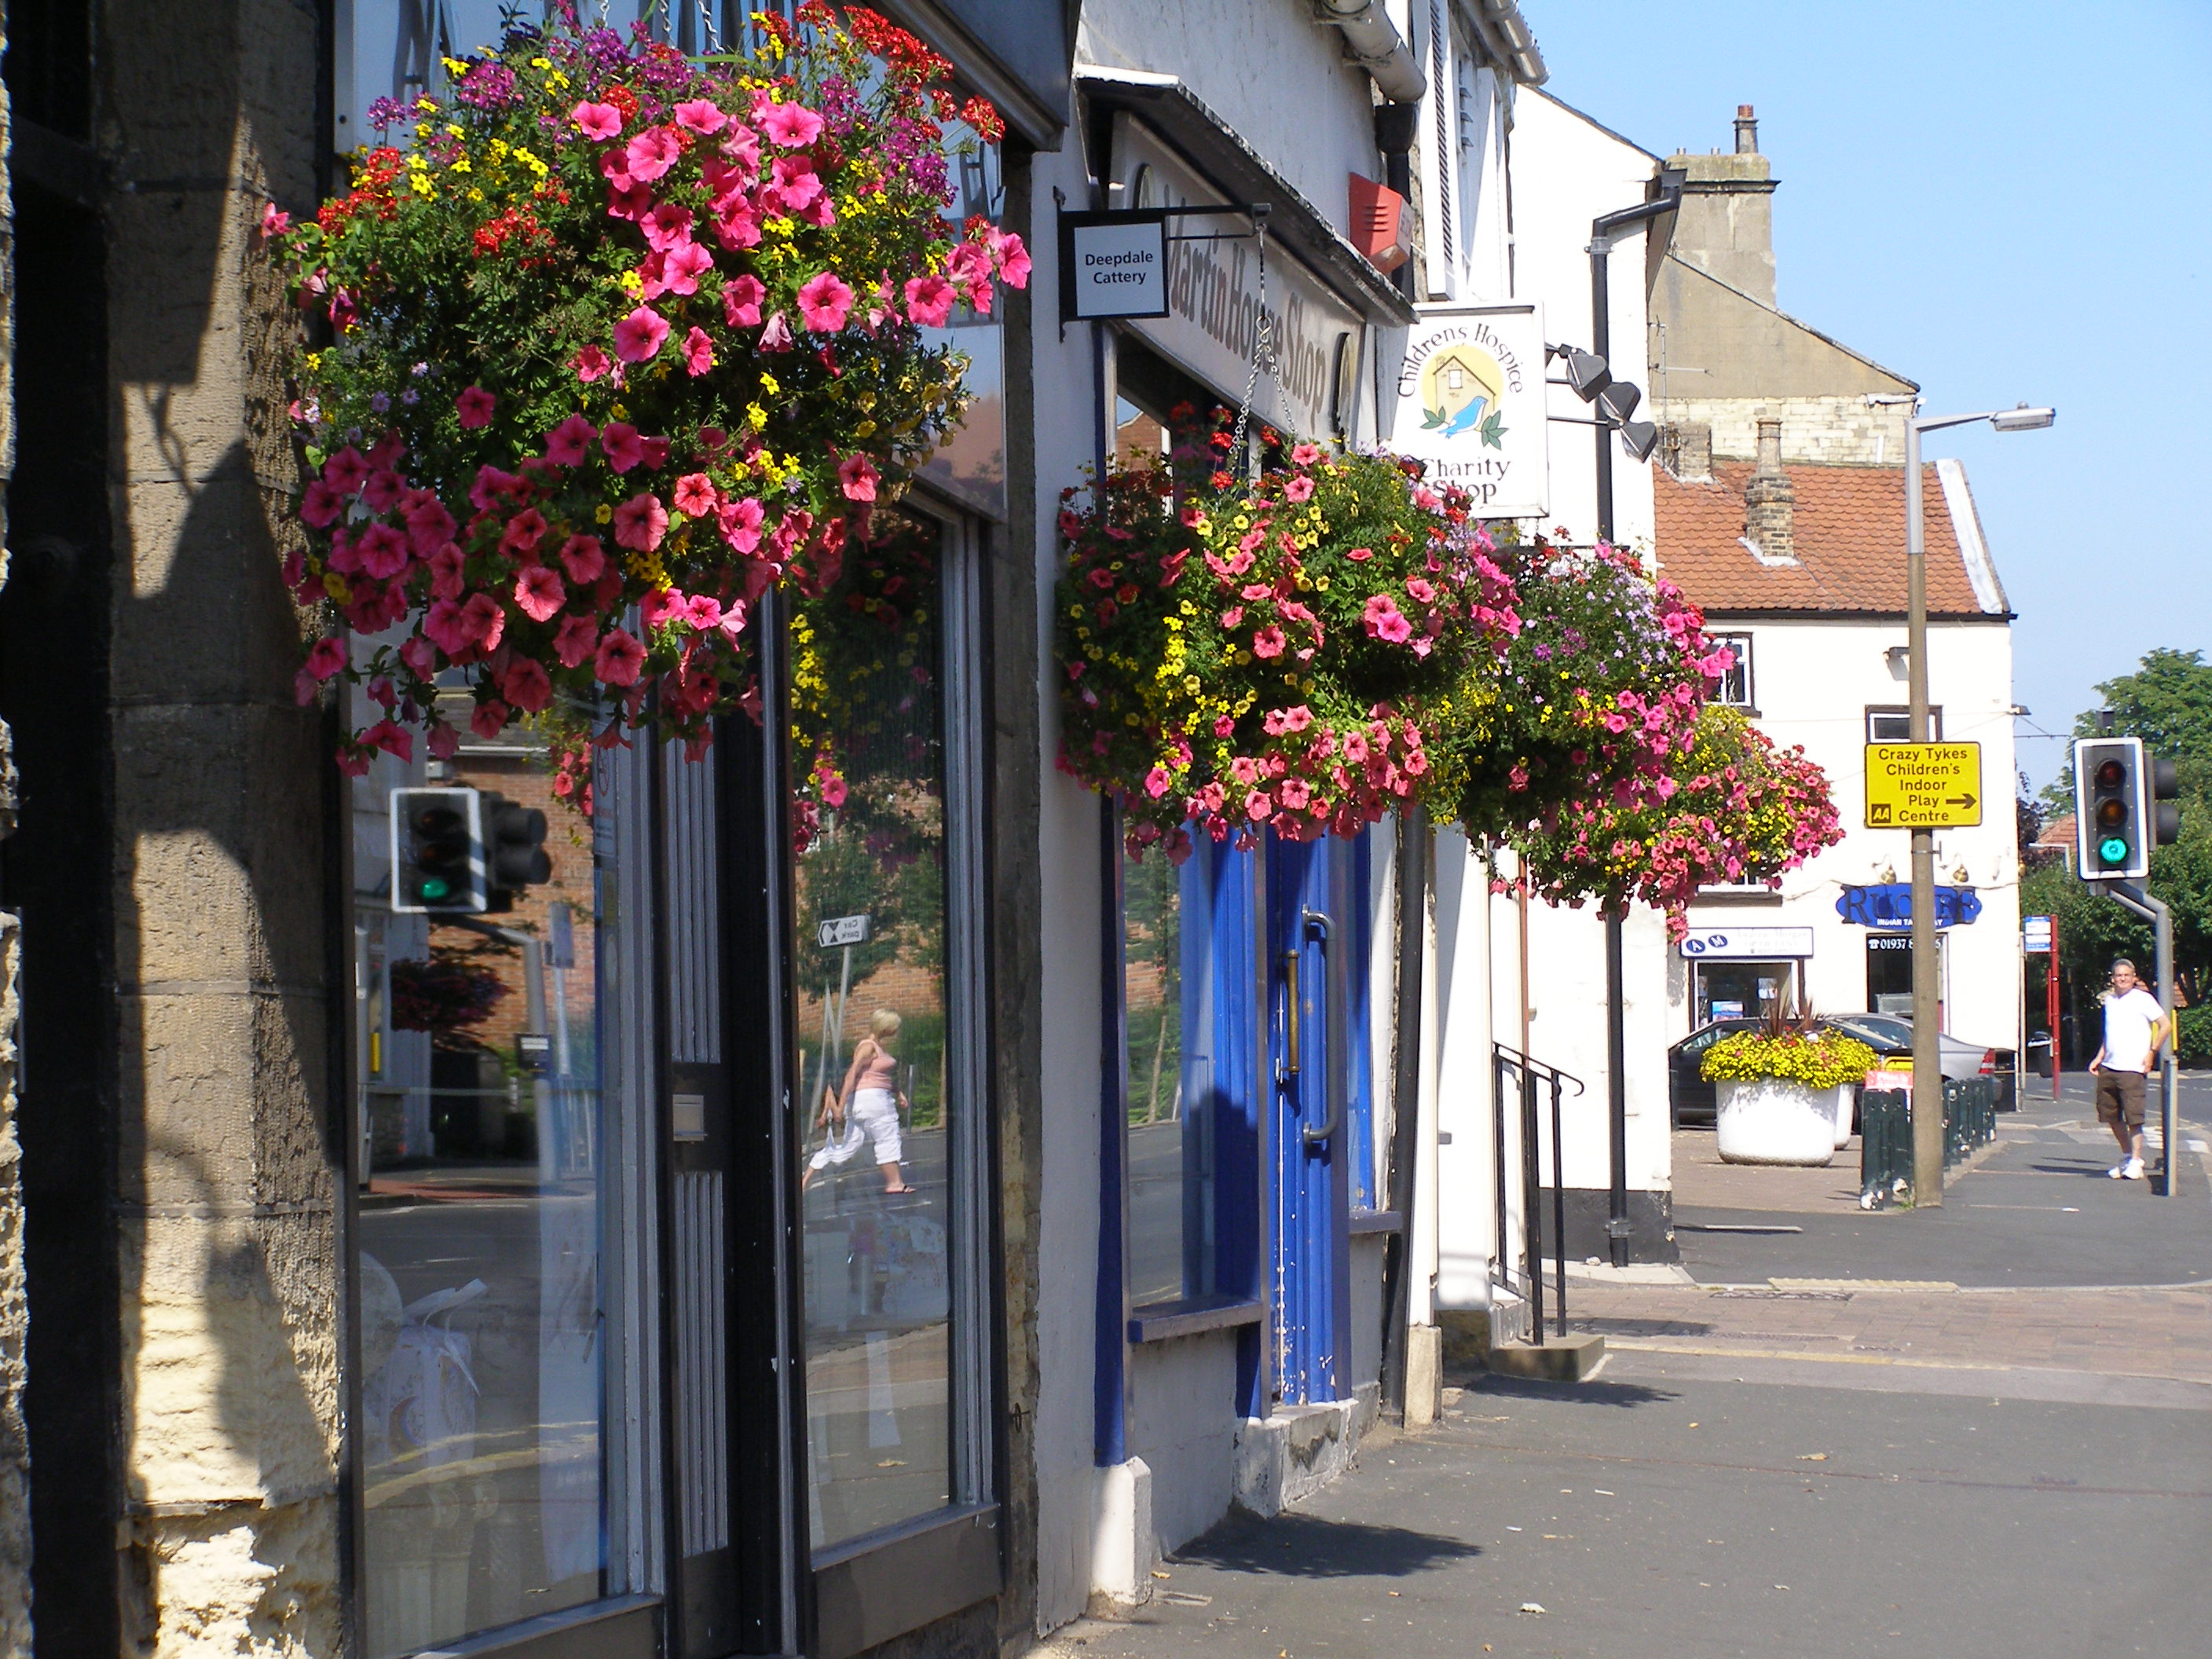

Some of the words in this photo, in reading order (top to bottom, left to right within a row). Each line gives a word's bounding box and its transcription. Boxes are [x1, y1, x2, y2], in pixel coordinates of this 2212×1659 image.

[1085, 250, 1153, 268] Deepdale
[1093, 272, 1146, 285] Cattery
[1164, 185, 1227, 343] Martin
[1282, 291, 1326, 434] Shop
[1397, 325, 1468, 397] Childrens
[1474, 322, 1523, 394] Hospice
[1422, 456, 1511, 482] Charity
[1878, 748, 1920, 761] Crazy
[1925, 747, 1968, 760] Tykes
[1886, 763, 1961, 775] Children's
[1899, 778, 1947, 790] Indoor
[1909, 794, 1939, 808] Play
[1873, 807, 1890, 821] AA
[1899, 809, 1950, 822] Centre
[1877, 917, 1903, 926] INDIAN
[1880, 938, 1906, 950] 01937
